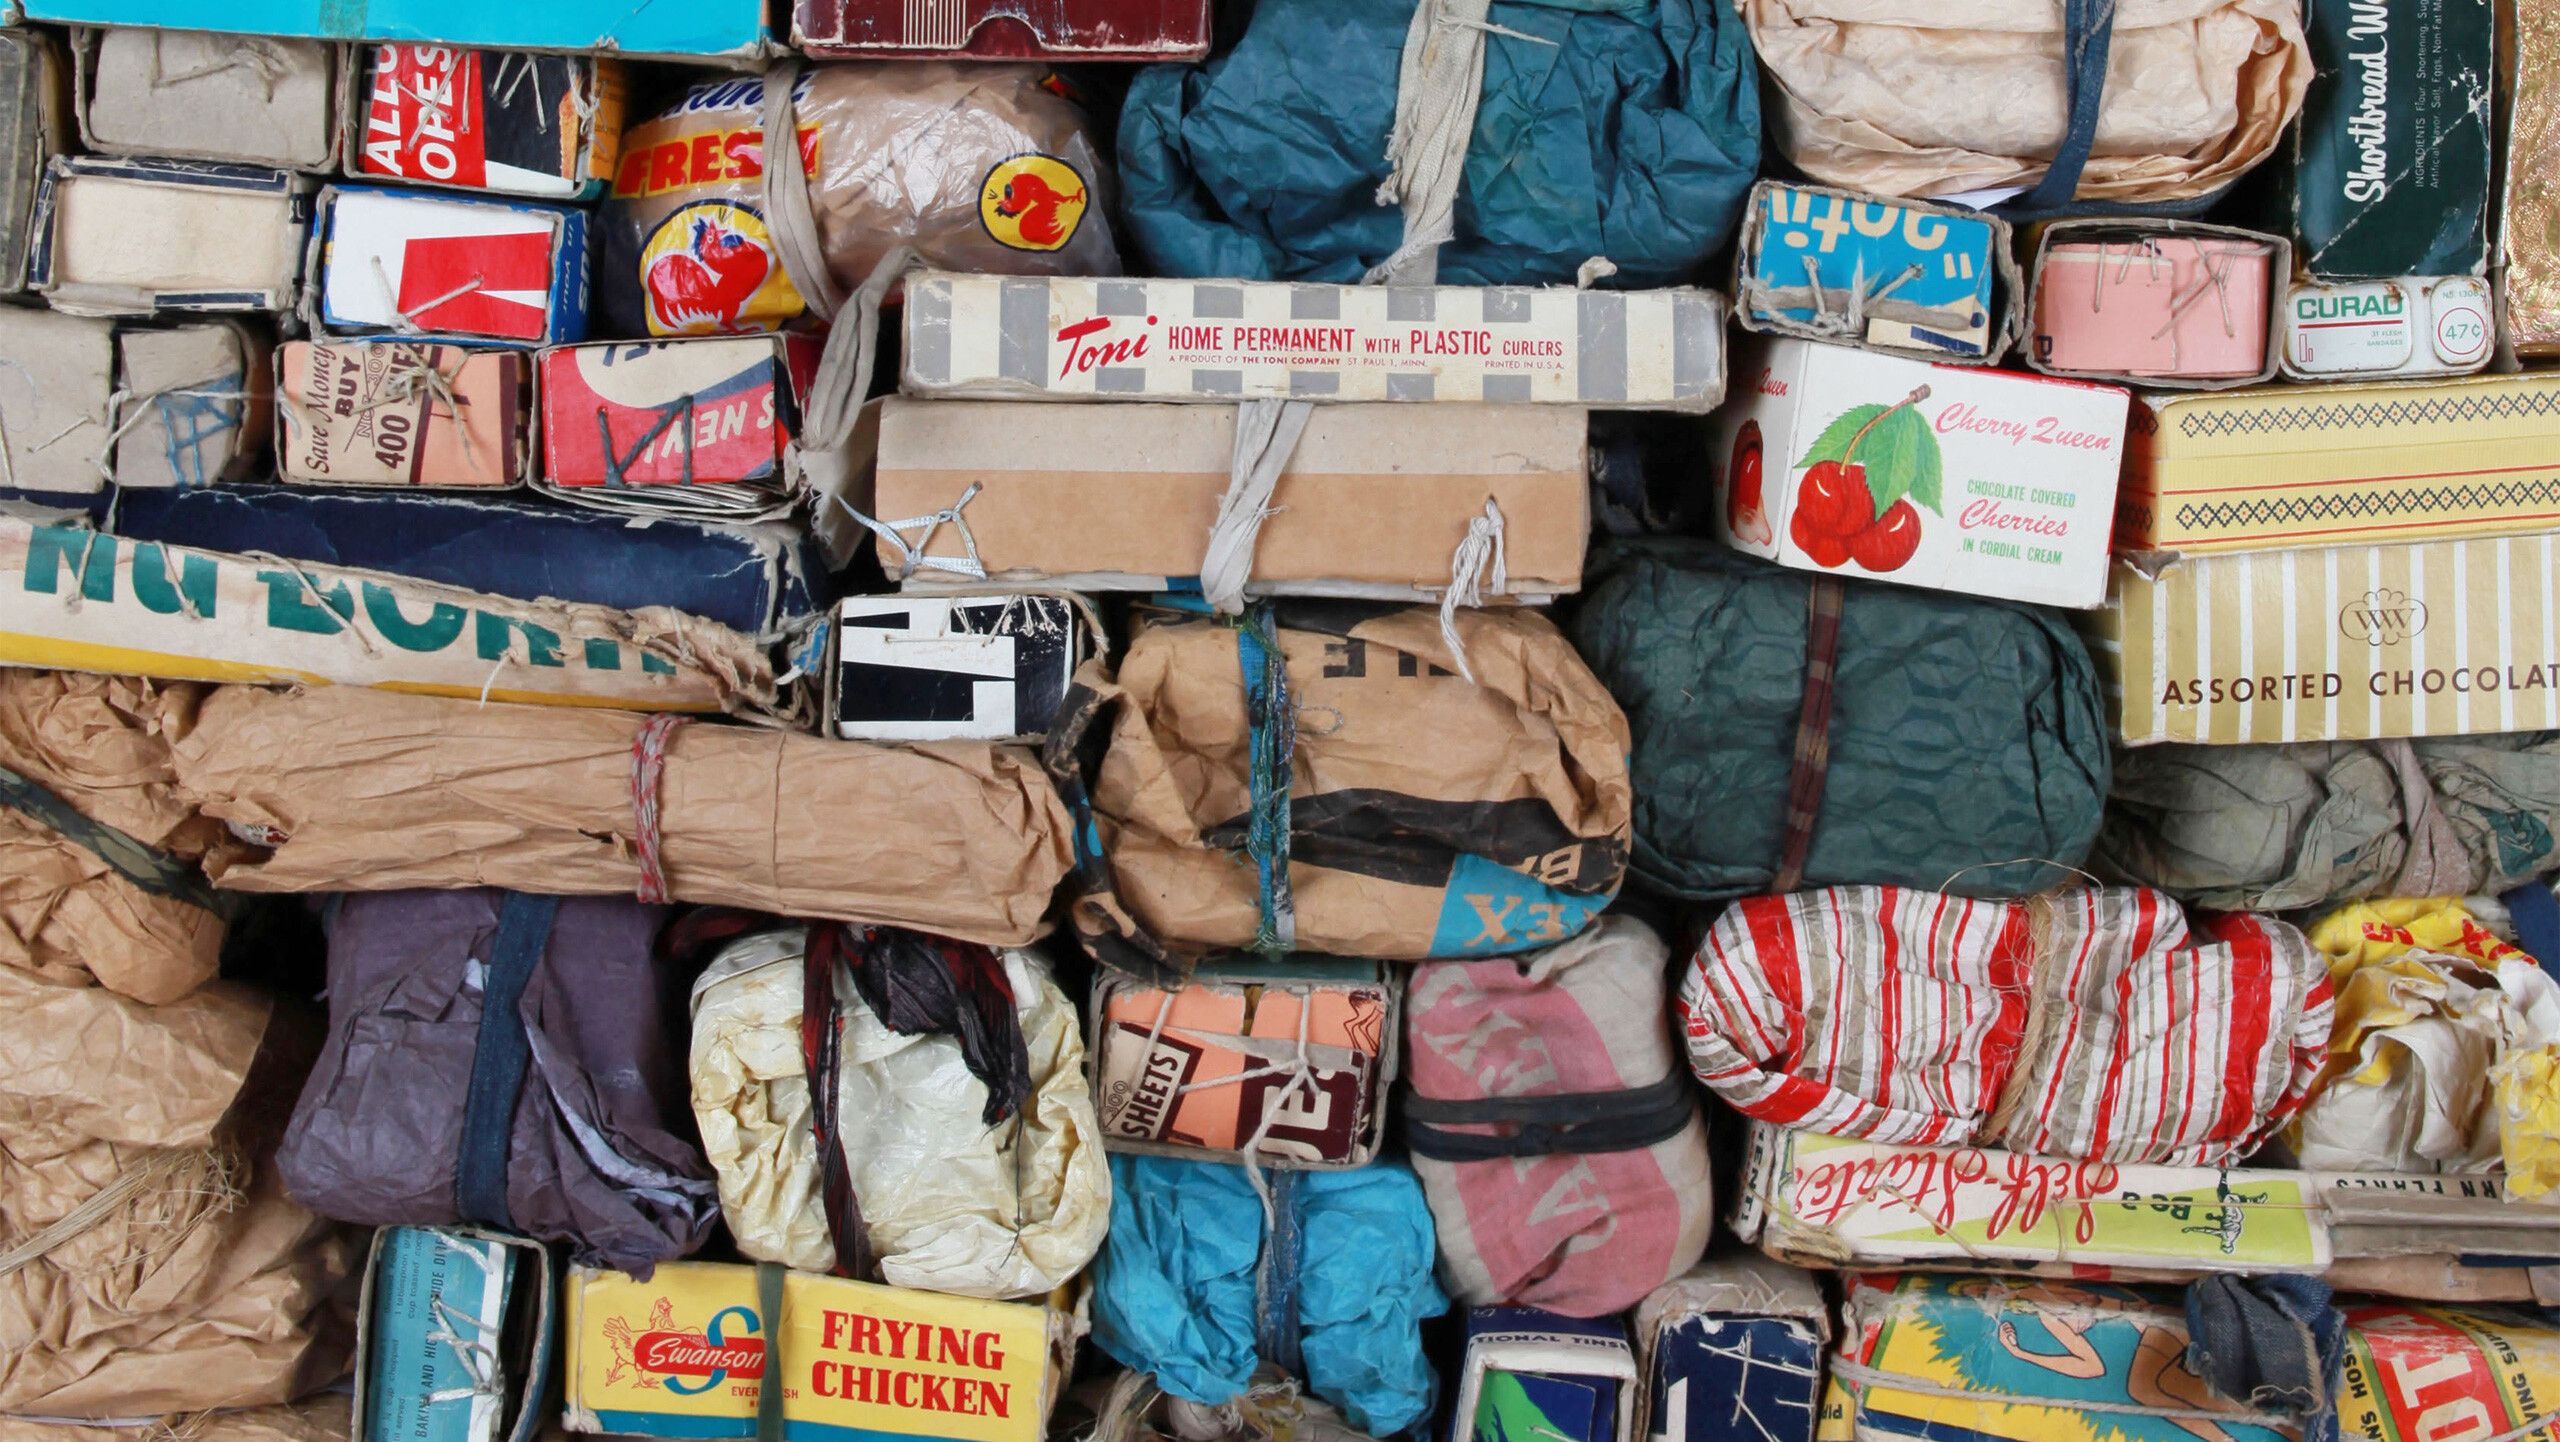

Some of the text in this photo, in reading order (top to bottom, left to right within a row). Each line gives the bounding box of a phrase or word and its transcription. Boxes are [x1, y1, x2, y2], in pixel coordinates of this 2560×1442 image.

[2344, 35, 2387, 202] Shortbread
[2297, 295, 2403, 319] CURAD
[1057, 314, 1563, 381] Toni HOME PERMANENT WITH PLASTIC CURLERS
[1179, 355, 1221, 363] PRODUCT
[1242, 356, 1259, 364] THE
[1263, 356, 1287, 364] TONI
[1291, 356, 1340, 365] COMPANY
[1363, 358, 1385, 367] PAUL
[1485, 360, 1520, 369] PRINTED
[1524, 361, 1533, 369] IN
[335, 356, 361, 417] BUY
[305, 344, 336, 474] Save Money
[1935, 402, 2112, 451] Cherry Queen
[375, 414, 411, 470] 400
[1967, 479, 2076, 509] CHOCOLATE COVERED
[1959, 498, 2069, 537] Cherries
[1962, 537, 2062, 565] IN CORDIAL CREAM
[2161, 673, 2343, 705] ASSORTED
[1121, 1052, 1179, 1139] SHEETS
[2121, 1191, 2141, 1210] a
[2150, 1193, 2193, 1220] Be
[648, 1337, 764, 1368] Swanson
[821, 1310, 1005, 1371] FRYING
[421, 1364, 435, 1388] AND
[812, 1360, 1011, 1418] CHICKEN
